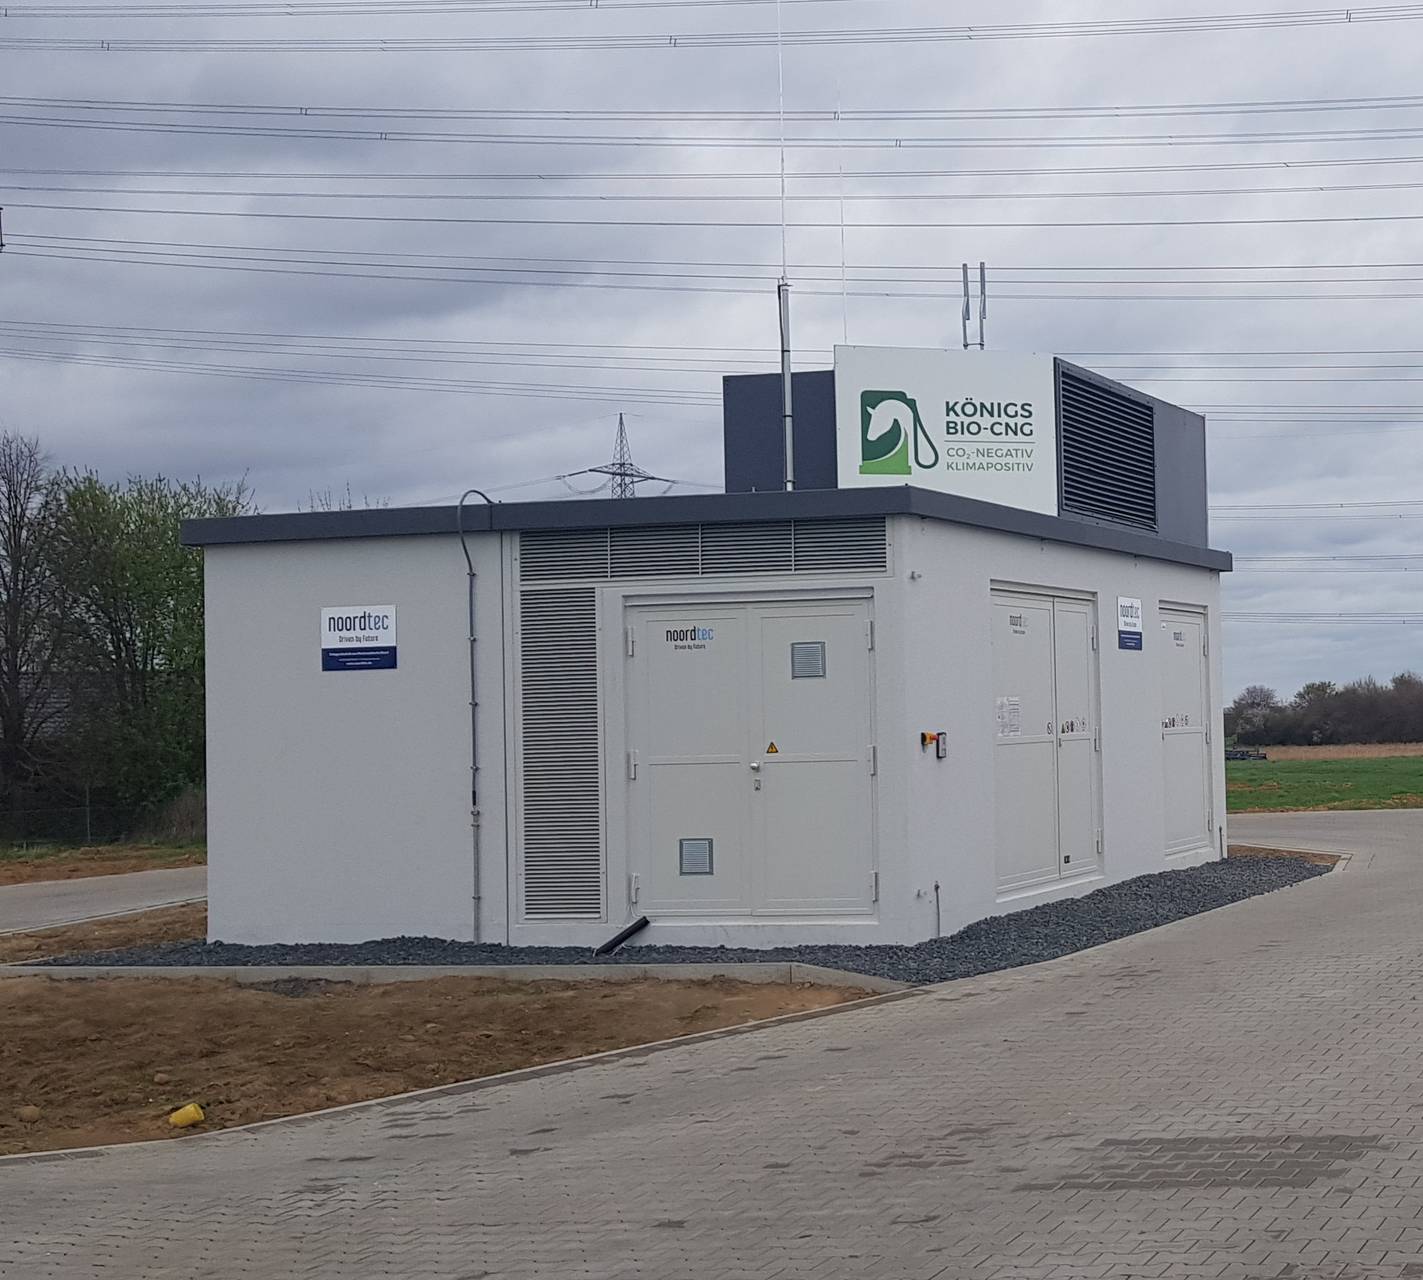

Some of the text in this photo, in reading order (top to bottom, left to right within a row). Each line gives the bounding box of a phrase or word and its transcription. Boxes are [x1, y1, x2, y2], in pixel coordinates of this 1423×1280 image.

[945, 397, 1033, 419] KÖNIGS
[946, 421, 1033, 437] BIO-CNG
[946, 461, 1034, 472] KLIMAPOSITIV
[328, 611, 389, 632] noordtec
[665, 625, 714, 642] noordtec
